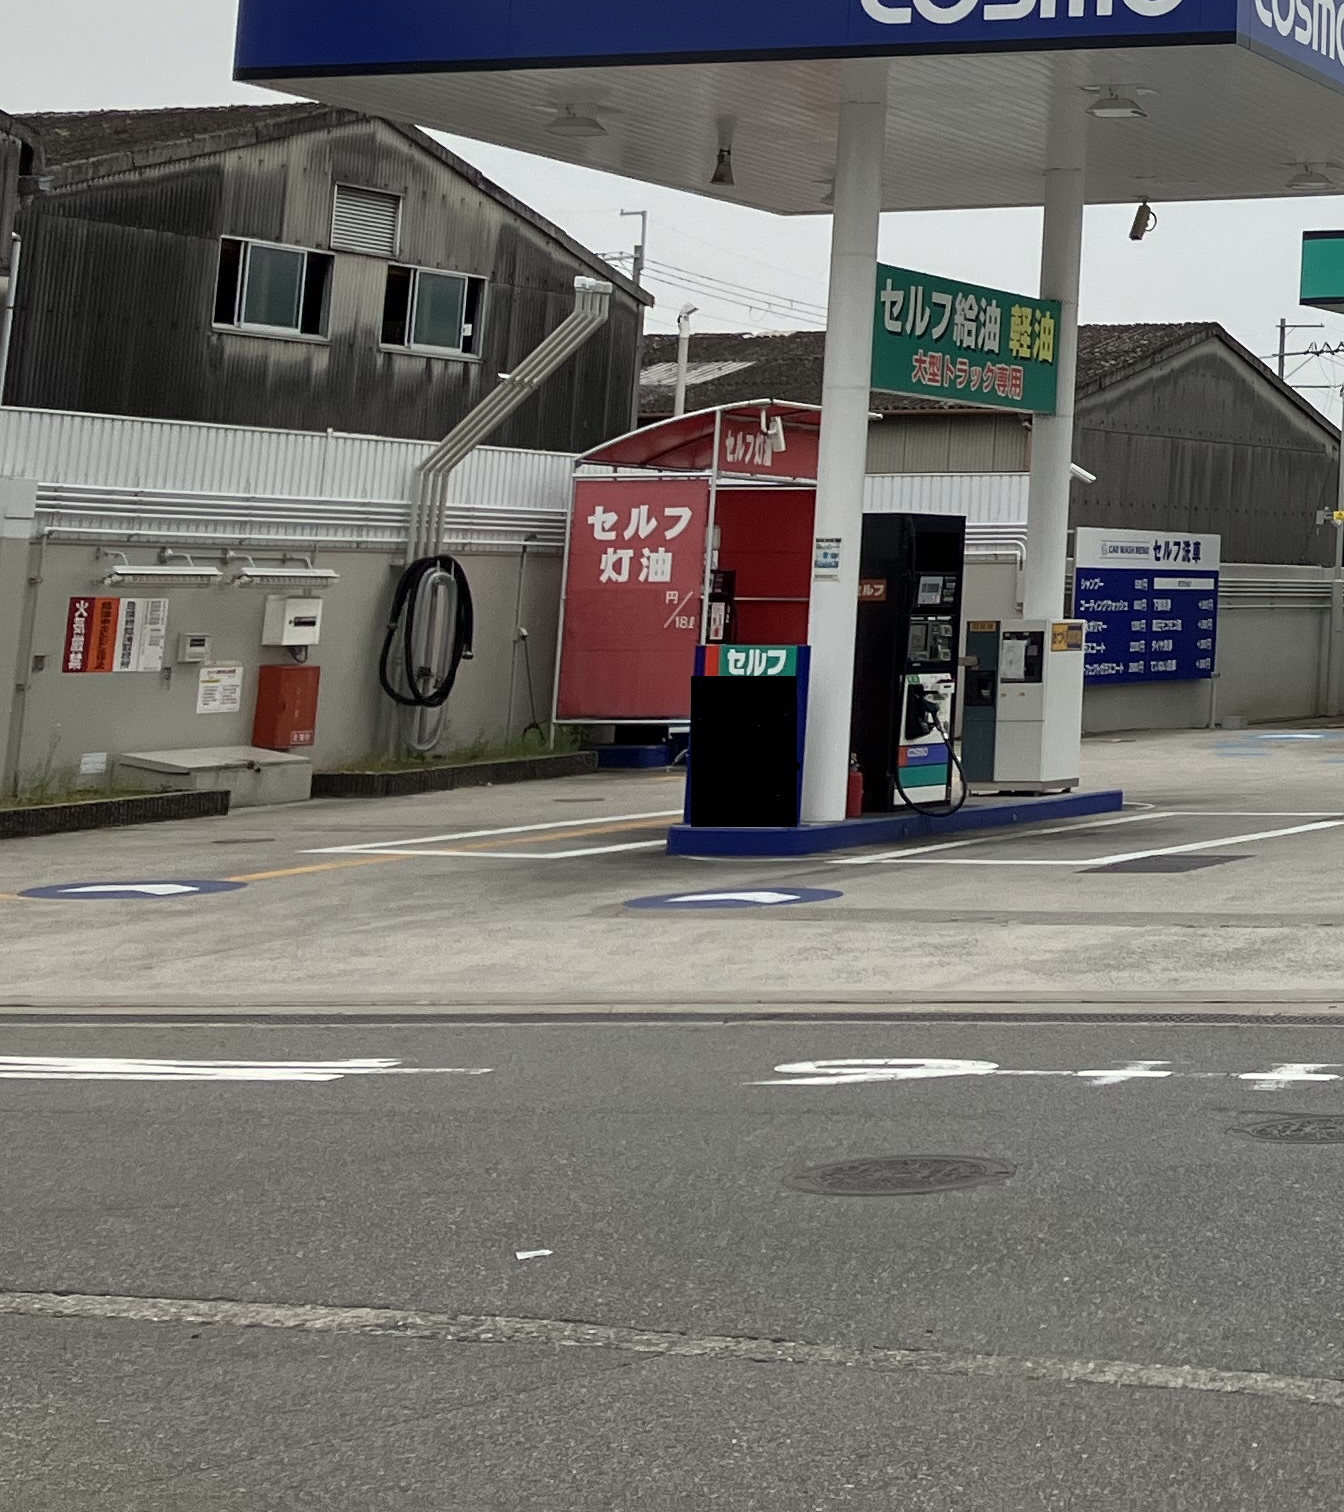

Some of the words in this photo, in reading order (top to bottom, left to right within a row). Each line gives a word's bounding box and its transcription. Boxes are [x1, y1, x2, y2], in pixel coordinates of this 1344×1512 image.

[880, 278, 1001, 354] セルフ給油
[1009, 303, 1056, 364] 軽油
[912, 349, 1024, 401] 大型トラック専用
[587, 505, 693, 540] セルフ
[600, 547, 673, 582] 灯油
[1153, 539, 1201, 563] セルフ洗車
[727, 649, 787, 676] セルフ
